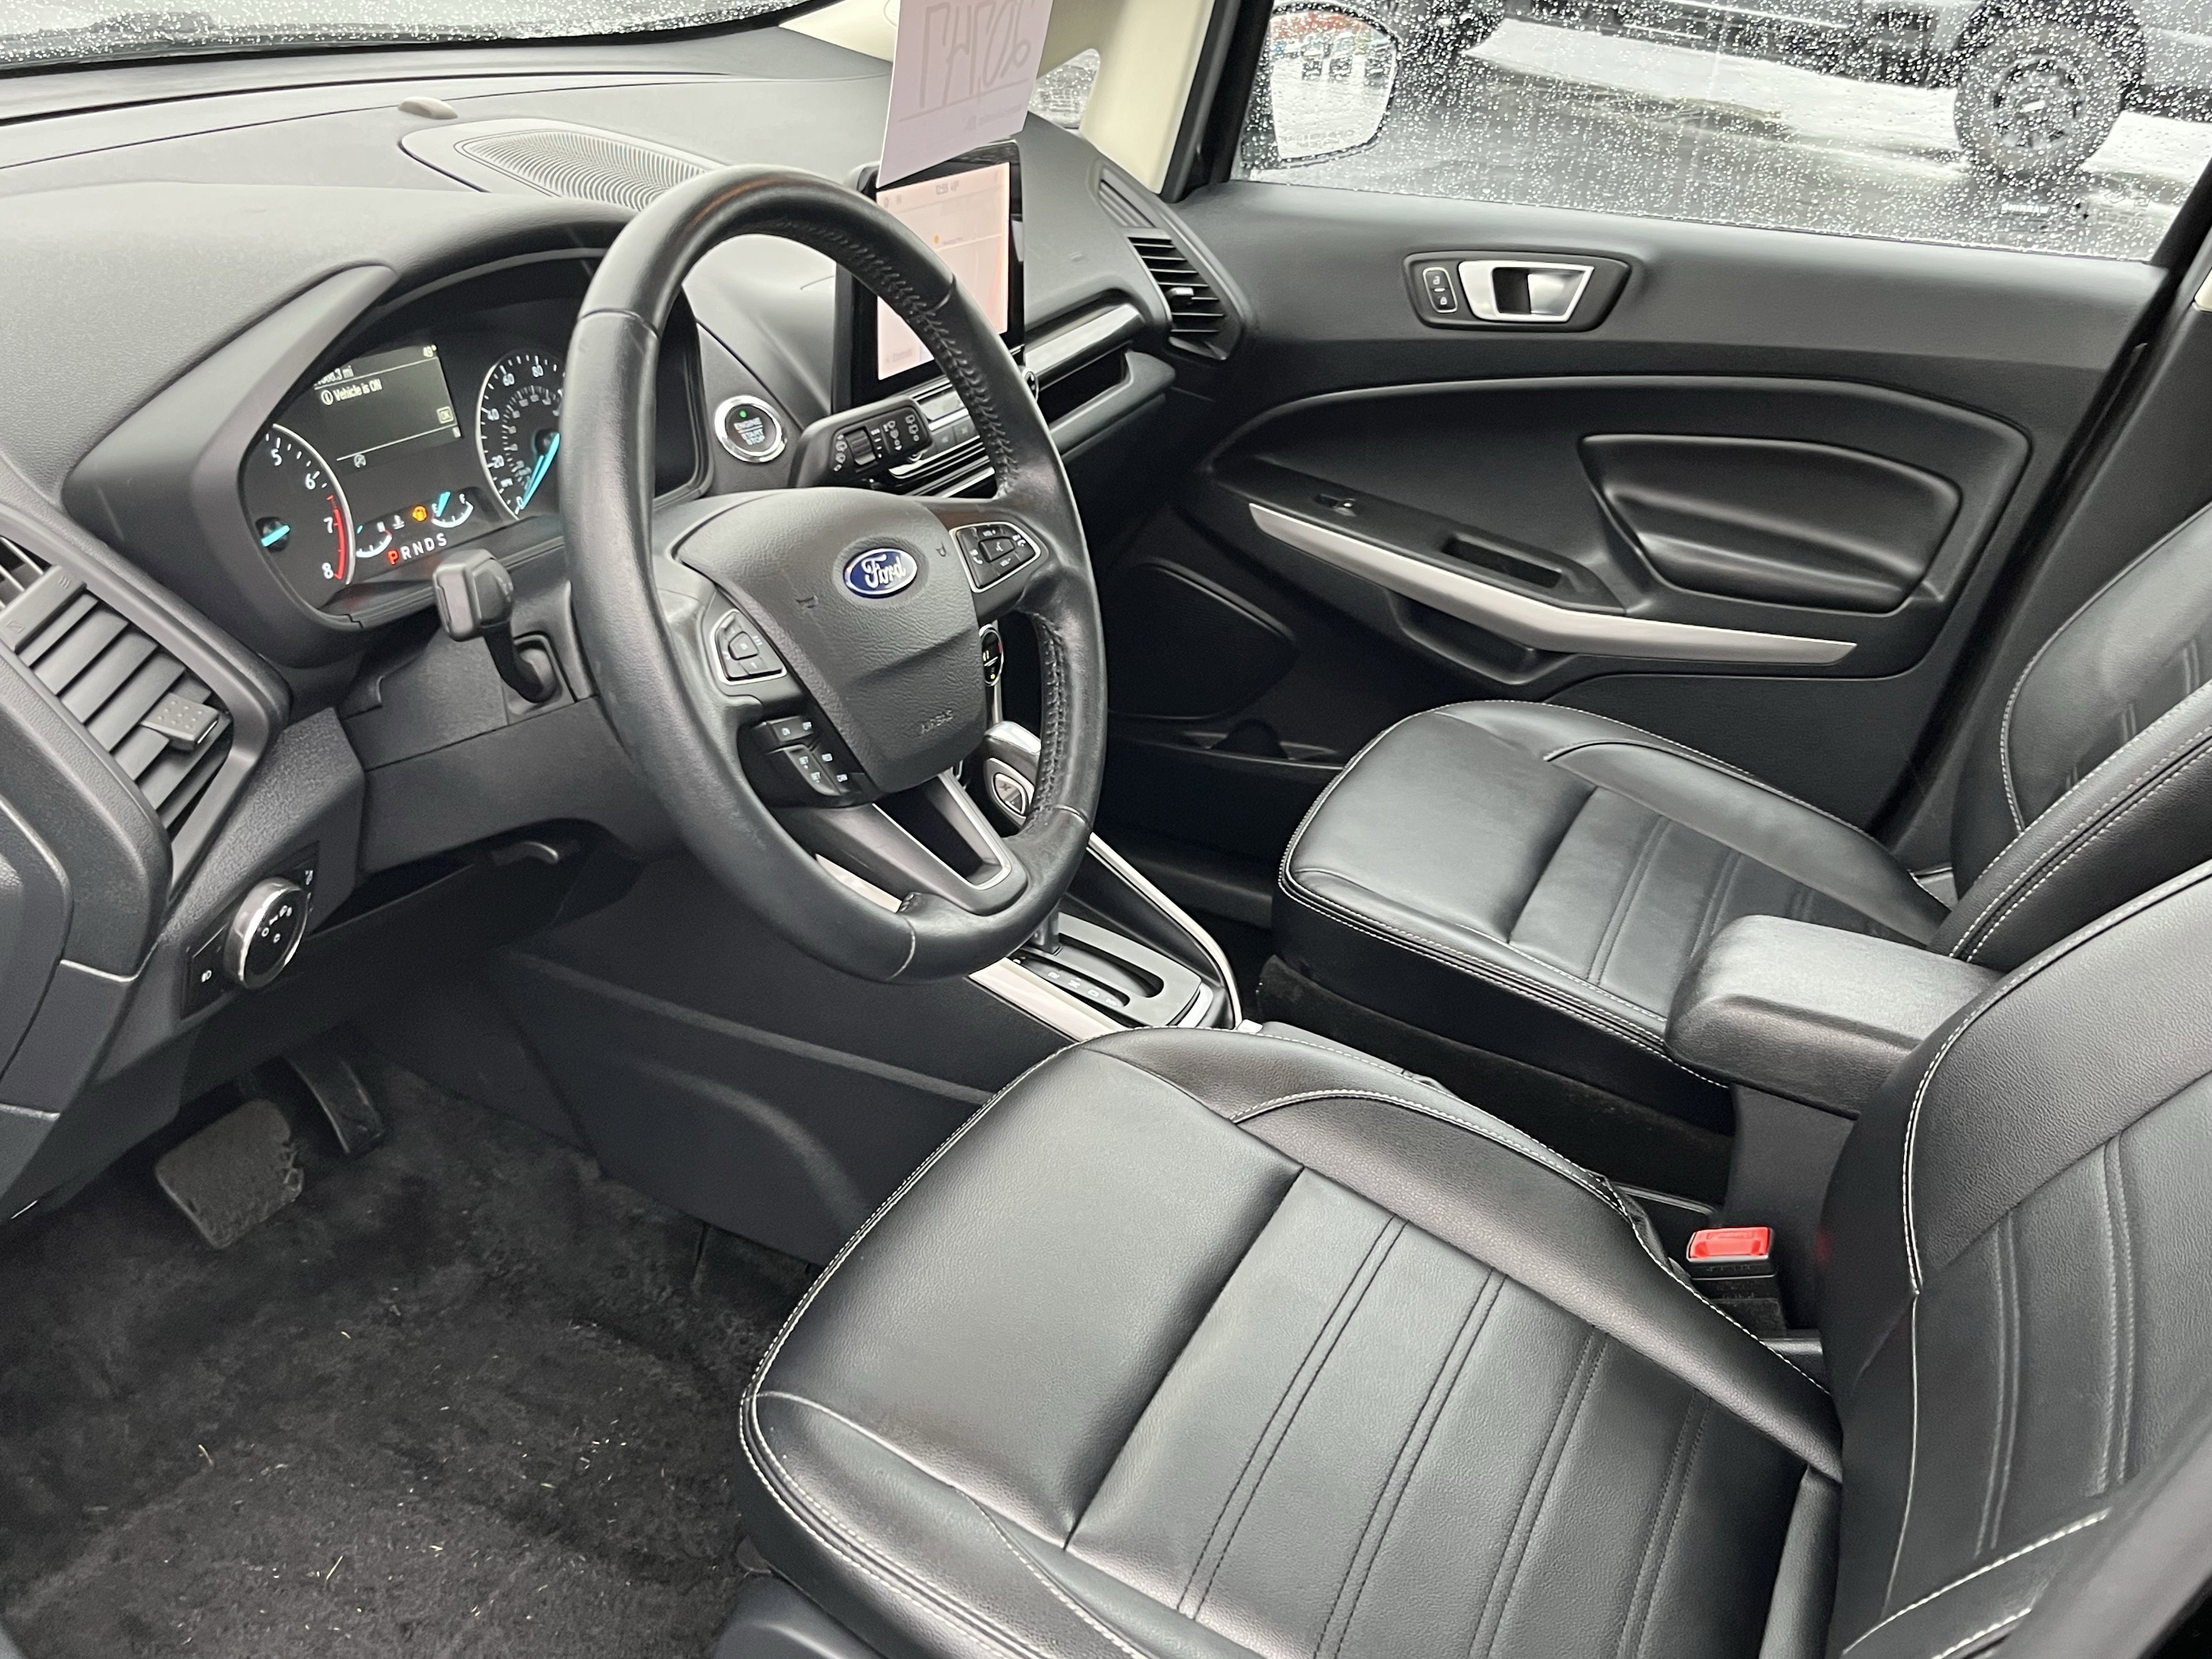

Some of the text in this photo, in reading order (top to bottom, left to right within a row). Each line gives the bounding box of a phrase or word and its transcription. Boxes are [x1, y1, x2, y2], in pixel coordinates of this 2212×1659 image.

[503, 373, 515, 386] 60
[532, 365, 544, 377] 80
[333, 379, 382, 401] Vehicle is ON
[741, 428, 764, 441] START
[271, 448, 282, 466] 5
[305, 473, 316, 490] 6
[323, 517, 333, 533] 7
[387, 533, 447, 565] P R N D S
[321, 562, 334, 579] 8
[861, 554, 906, 588] Ford
